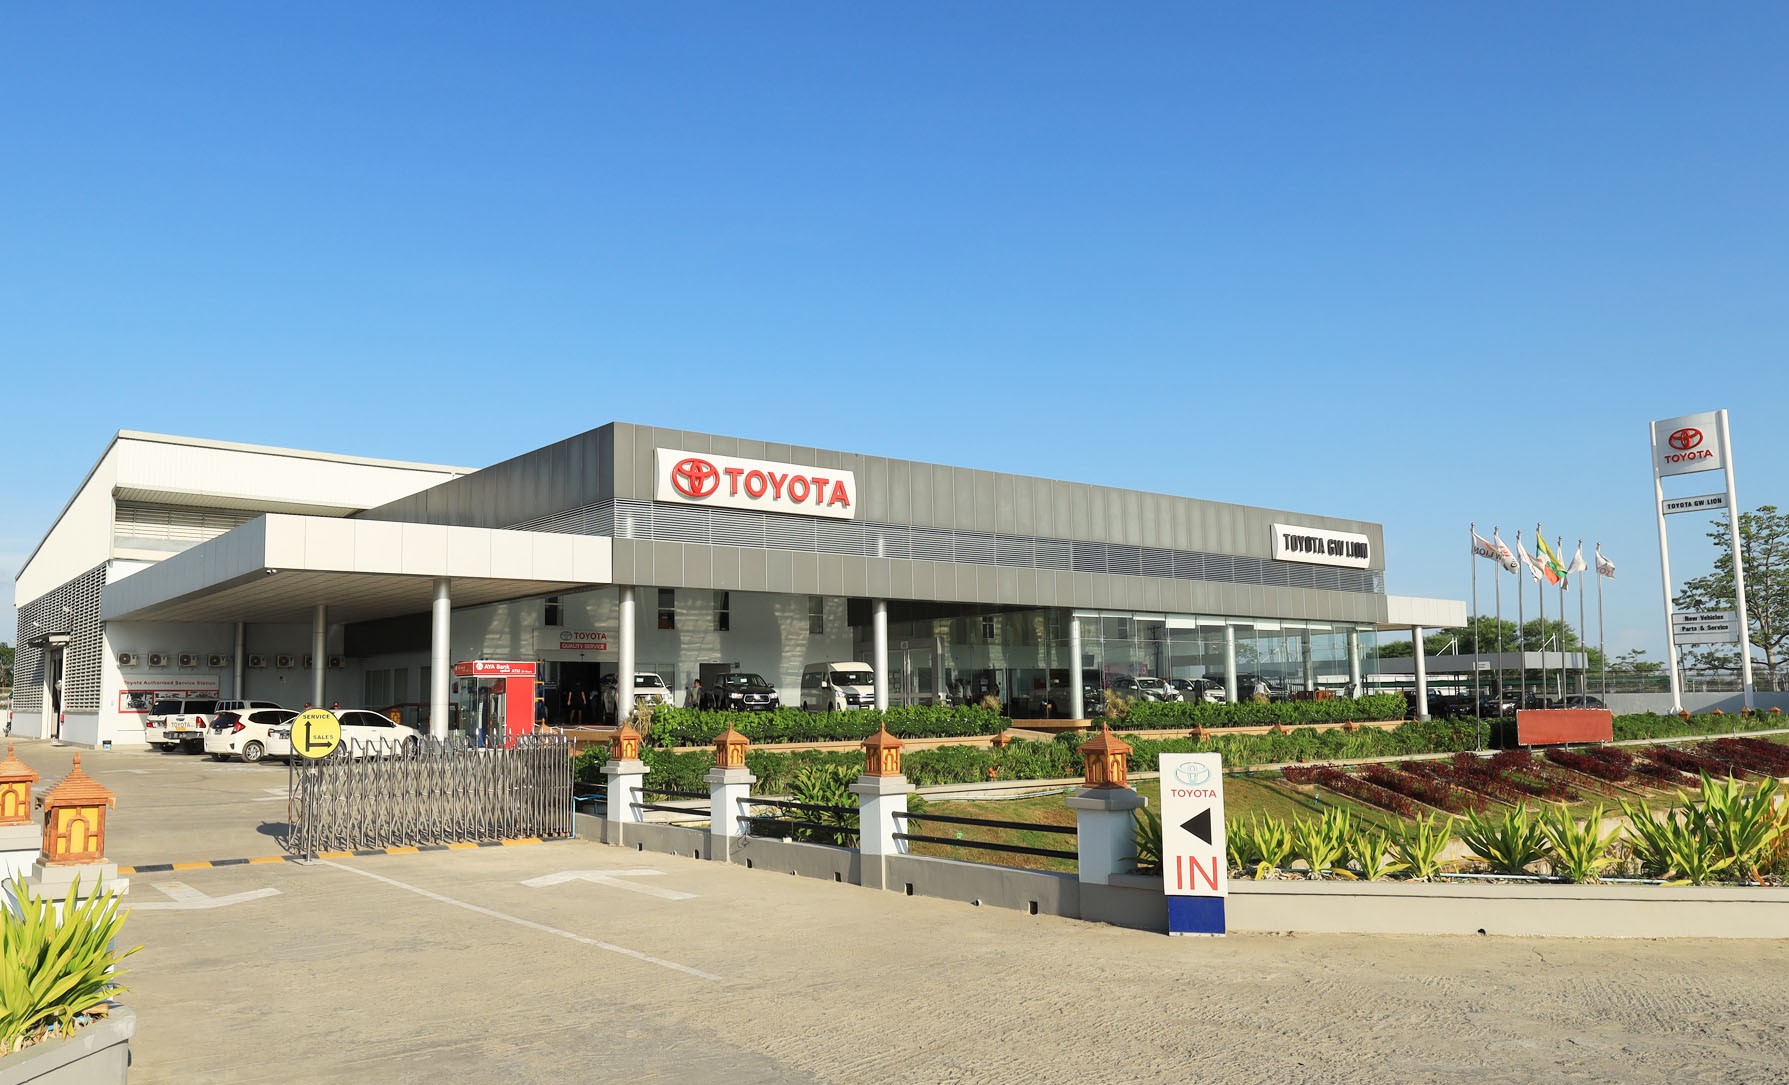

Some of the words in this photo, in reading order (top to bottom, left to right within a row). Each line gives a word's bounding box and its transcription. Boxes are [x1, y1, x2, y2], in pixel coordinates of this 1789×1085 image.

[1664, 449, 1713, 463] TOYOTA
[724, 466, 850, 507] TOYOTA
[1667, 501, 1692, 509] TOYOTA
[1694, 499, 1705, 507] GW
[1283, 533, 1325, 554] TOYOTA
[1327, 538, 1344, 557] GW
[1345, 541, 1368, 559] LION
[574, 631, 607, 640] TOYOTA
[1170, 789, 1217, 798] TOYOTA
[1176, 855, 1218, 891] IN
